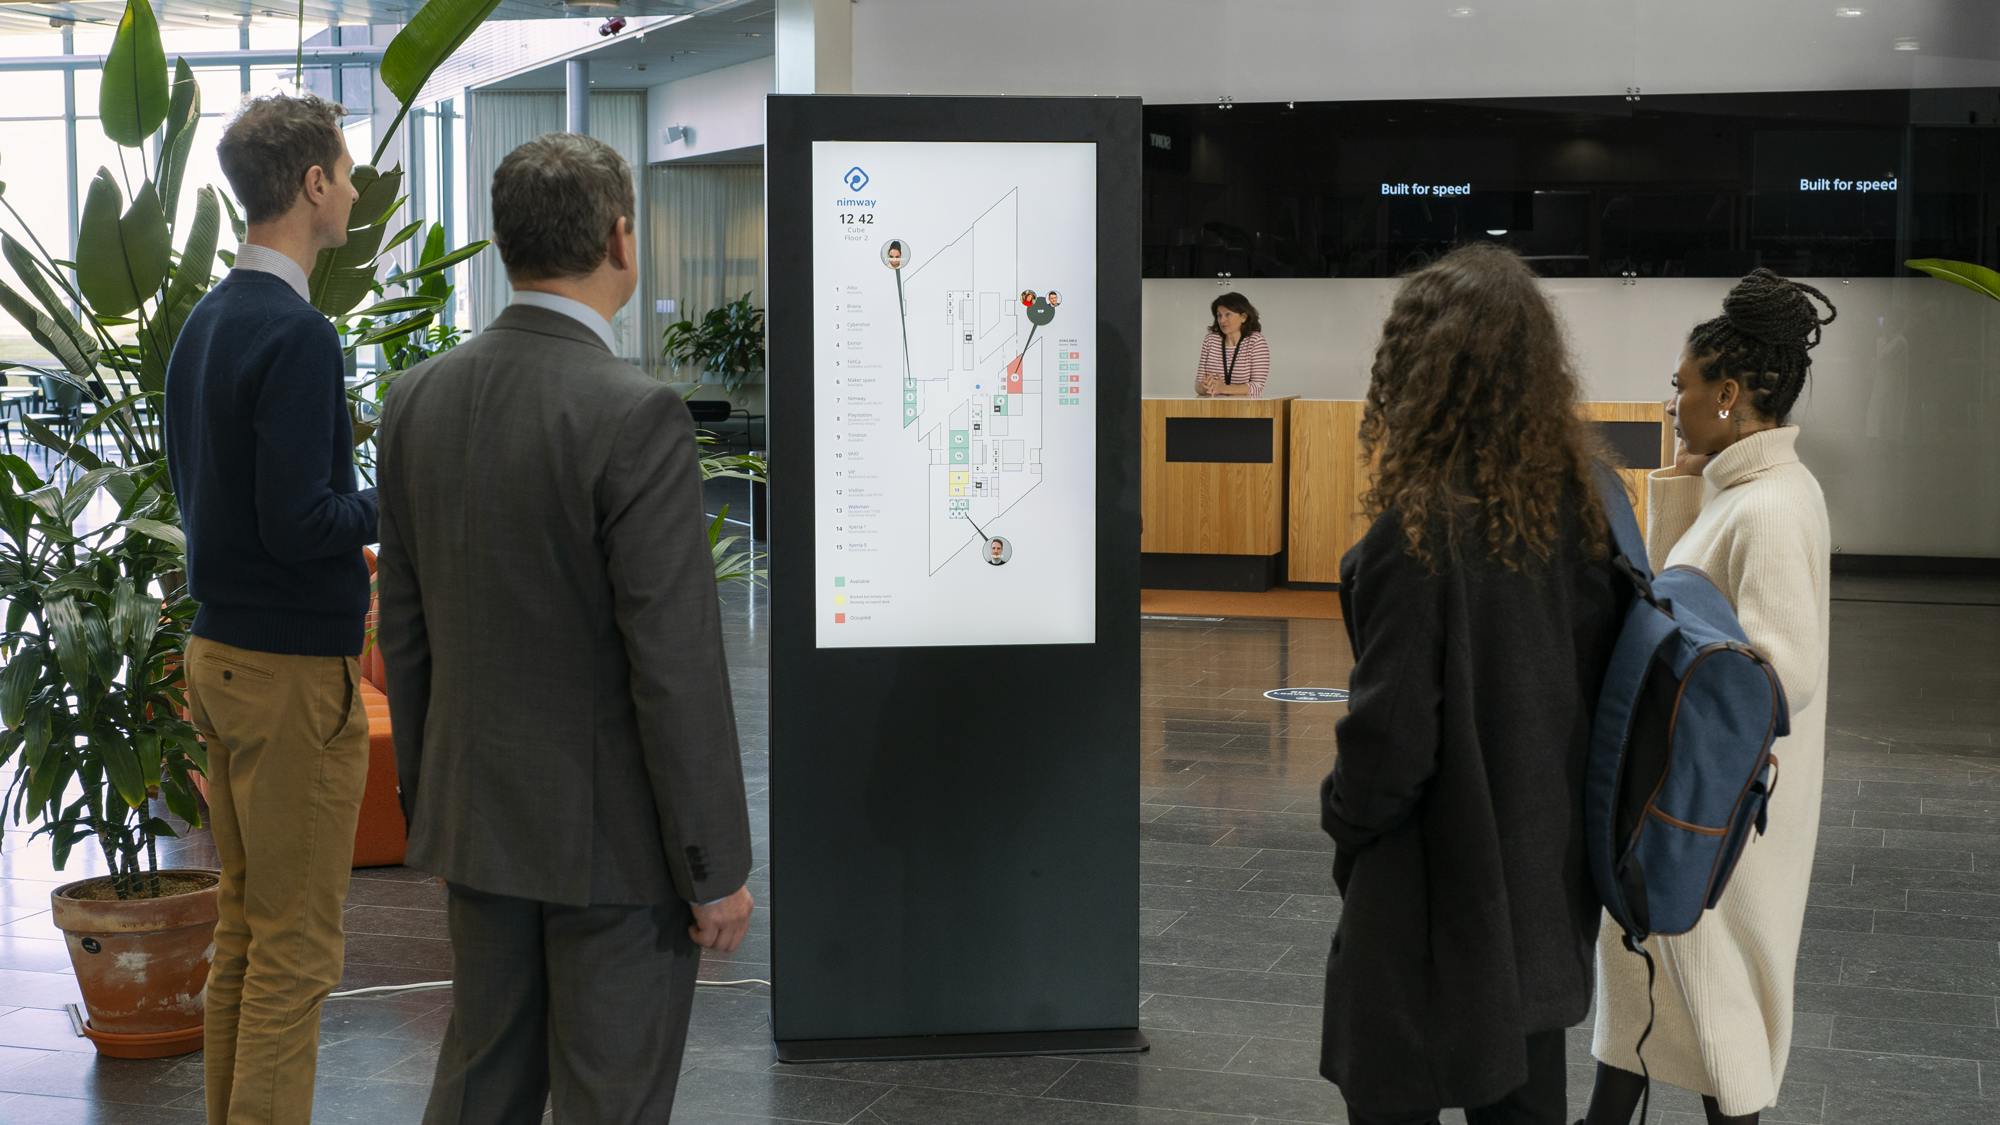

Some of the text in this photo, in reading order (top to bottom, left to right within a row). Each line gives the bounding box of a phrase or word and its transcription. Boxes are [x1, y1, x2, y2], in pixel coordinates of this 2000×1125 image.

[1381, 182, 1471, 197] Built for speed
[1800, 178, 1898, 193] Built for speed
[836, 197, 877, 208] nimway
[839, 213, 873, 224] 12 42
